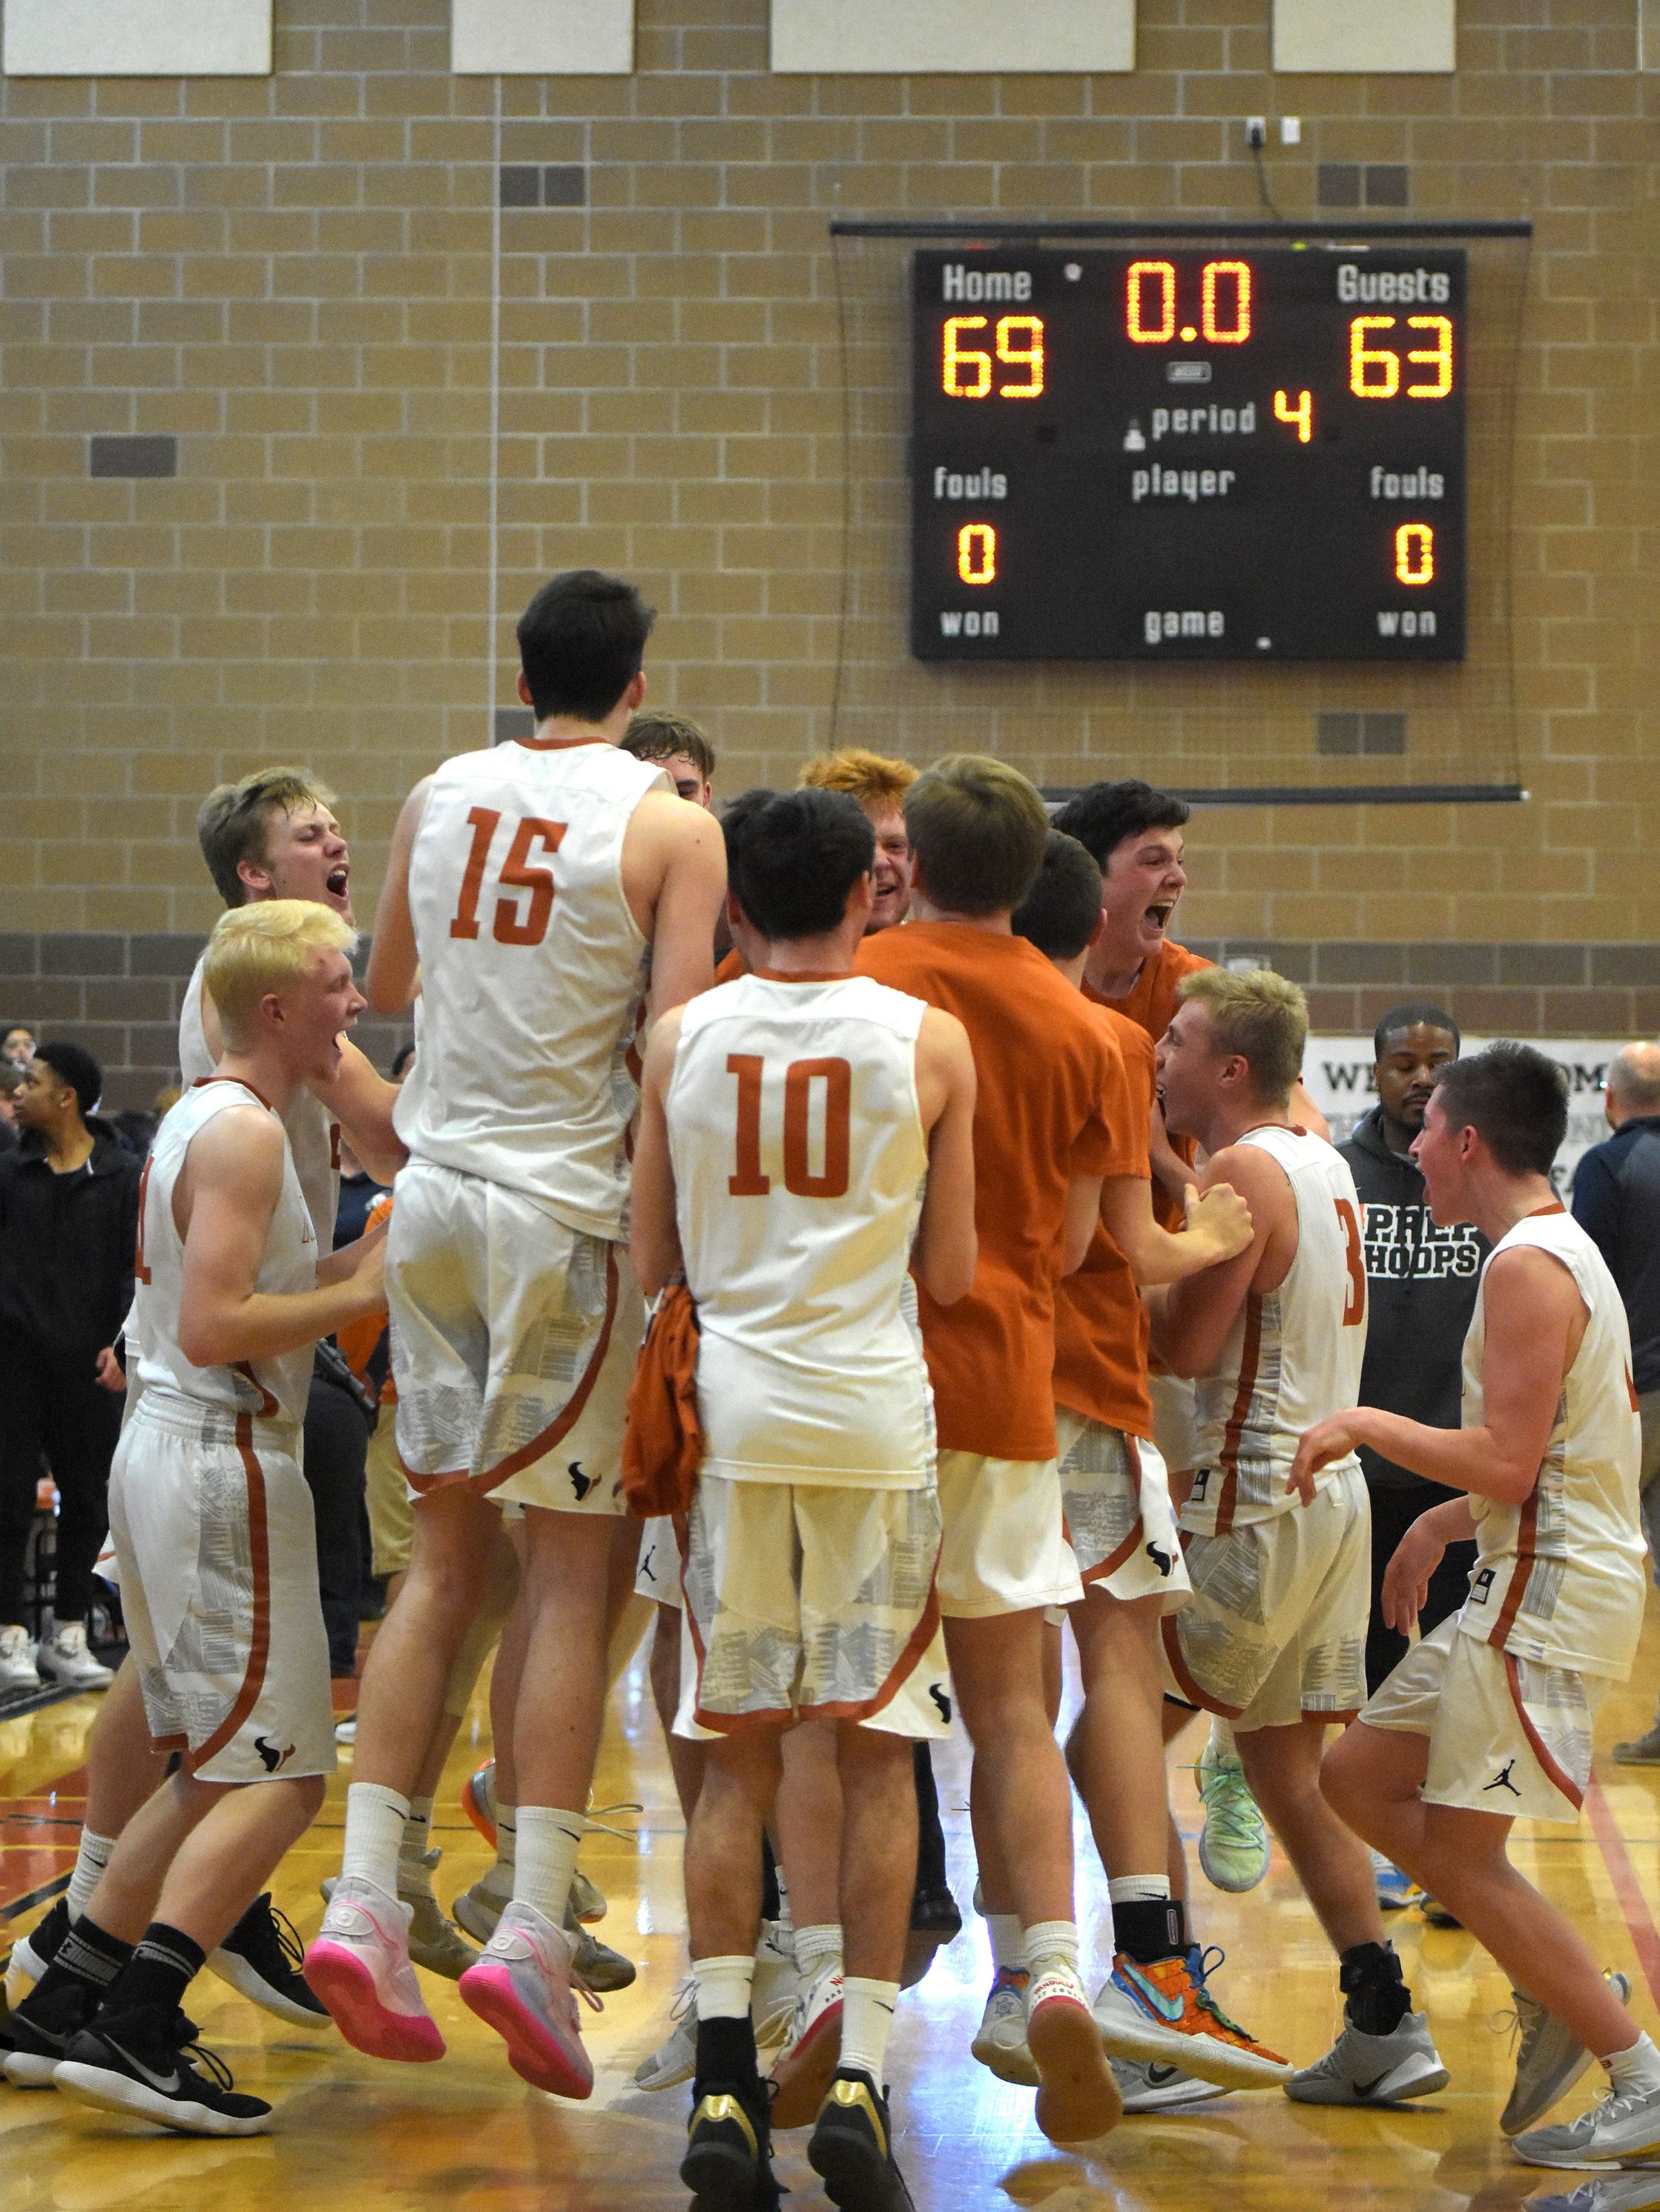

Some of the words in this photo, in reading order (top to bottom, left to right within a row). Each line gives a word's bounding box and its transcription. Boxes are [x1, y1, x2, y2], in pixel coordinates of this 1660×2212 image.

[943, 264, 1032, 302] Home
[1125, 260, 1252, 344] 0.0
[1337, 264, 1450, 303] Guests
[942, 315, 1045, 398] 69
[1349, 315, 1454, 398] 63
[1151, 401, 1256, 441] period
[1273, 390, 1313, 443] 4
[934, 466, 1007, 499] fouls
[1132, 464, 1236, 502] player
[1371, 466, 1445, 499] fouls
[957, 523, 997, 585] 0
[1394, 523, 1435, 585] 0
[940, 610, 1000, 637] won
[1144, 610, 1225, 645] game
[1377, 610, 1437, 637] won
[449, 806, 568, 946] 15
[727, 1053, 851, 1198] 10
[1334, 1198, 1366, 1327] 3
[1363, 1242, 1481, 1279] HOOPS
